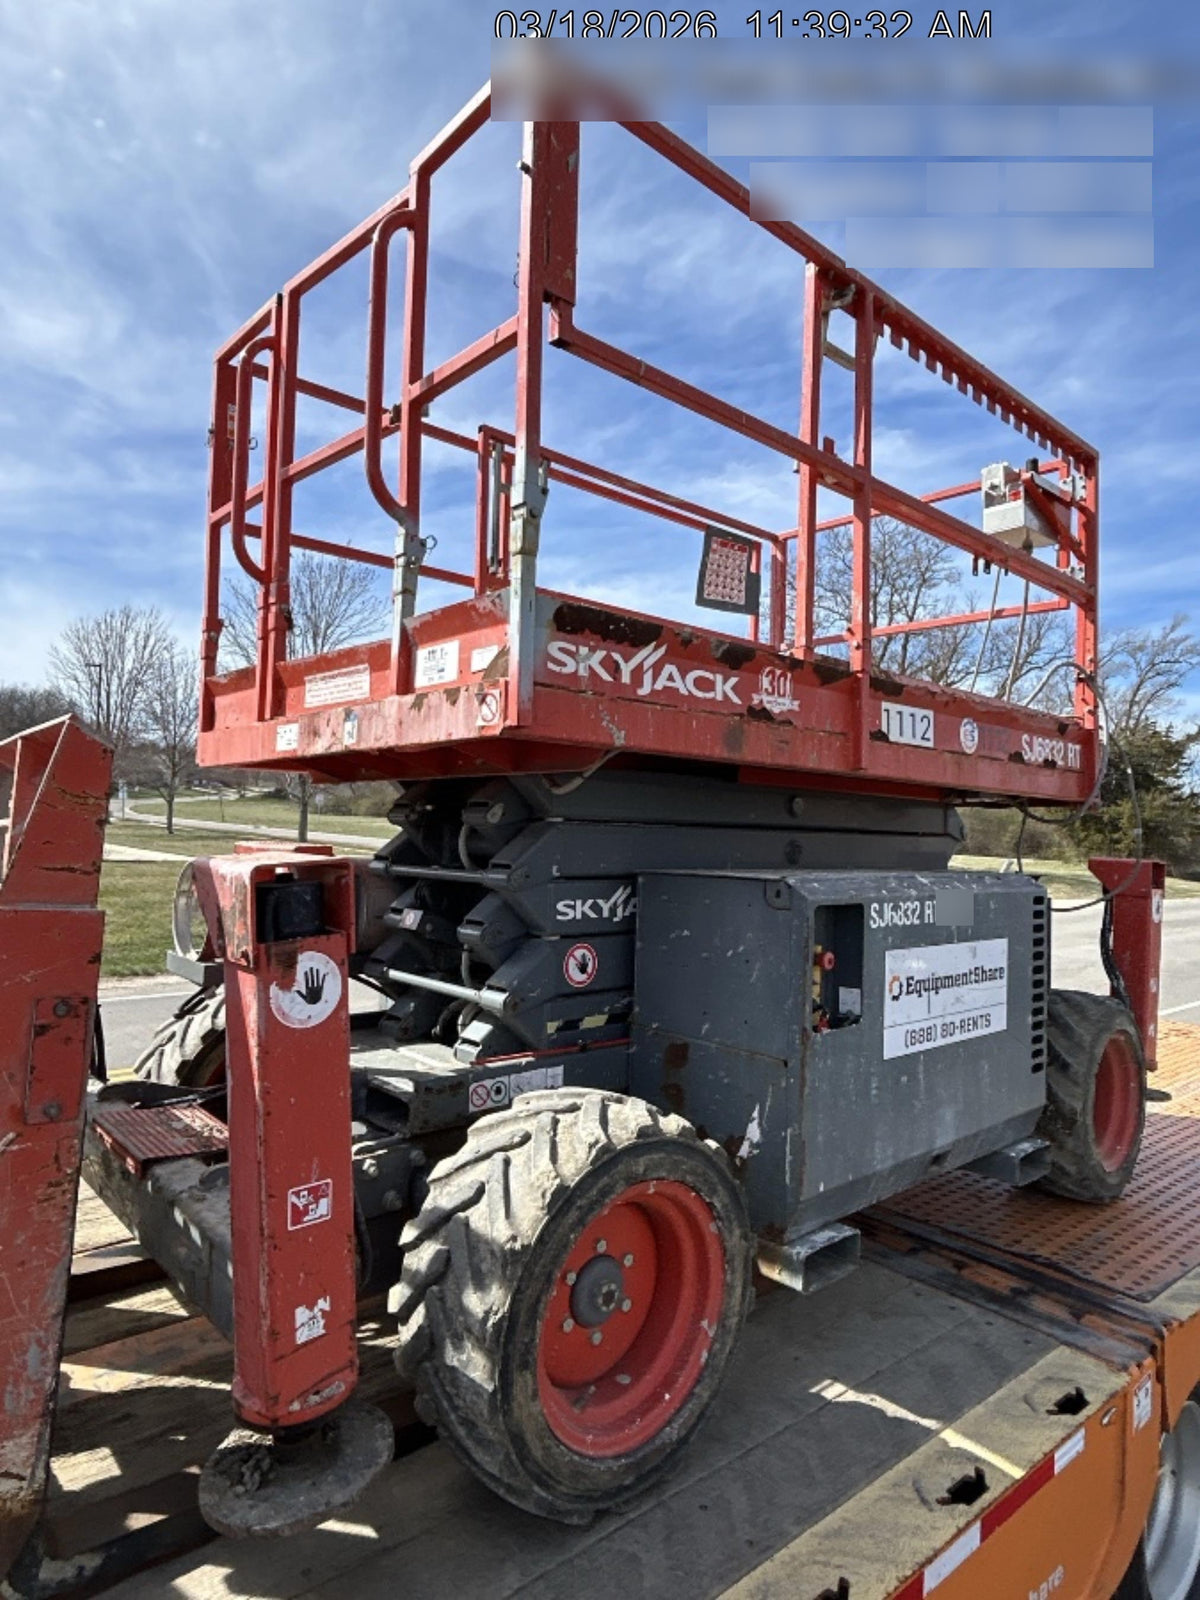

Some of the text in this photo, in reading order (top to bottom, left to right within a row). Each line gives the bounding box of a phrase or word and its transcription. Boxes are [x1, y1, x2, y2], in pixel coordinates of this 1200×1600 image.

[546, 640, 743, 705] SKYJACK
[883, 708, 931, 742] 1112
[923, 900, 937, 924] R
[904, 964, 1005, 998] EquipmentShare
